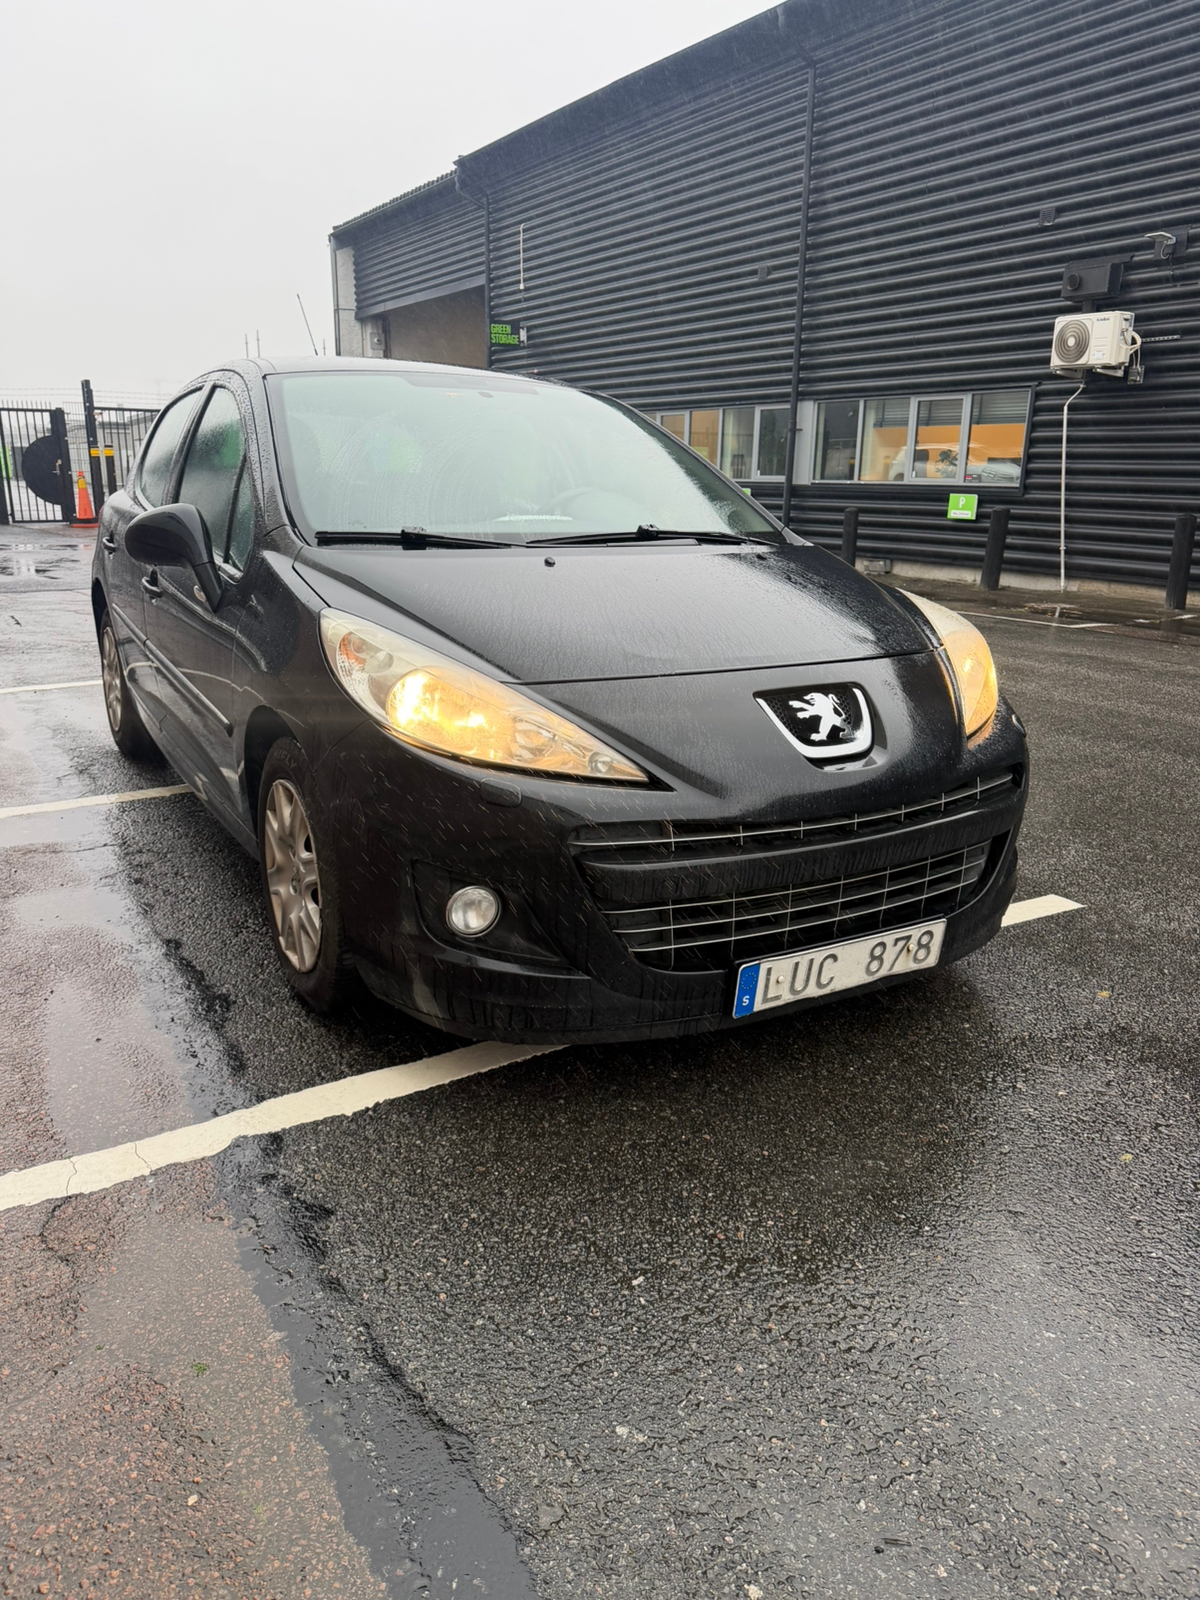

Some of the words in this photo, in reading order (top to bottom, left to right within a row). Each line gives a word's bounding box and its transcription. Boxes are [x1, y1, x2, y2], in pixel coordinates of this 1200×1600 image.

[490, 323, 511, 334] GREEN
[490, 333, 519, 345] STORAGE
[958, 496, 966, 509] P
[273, 748, 297, 769] HIFLY
[760, 953, 838, 1005] LUC
[865, 929, 935, 976] 878
[742, 995, 750, 1006] S
